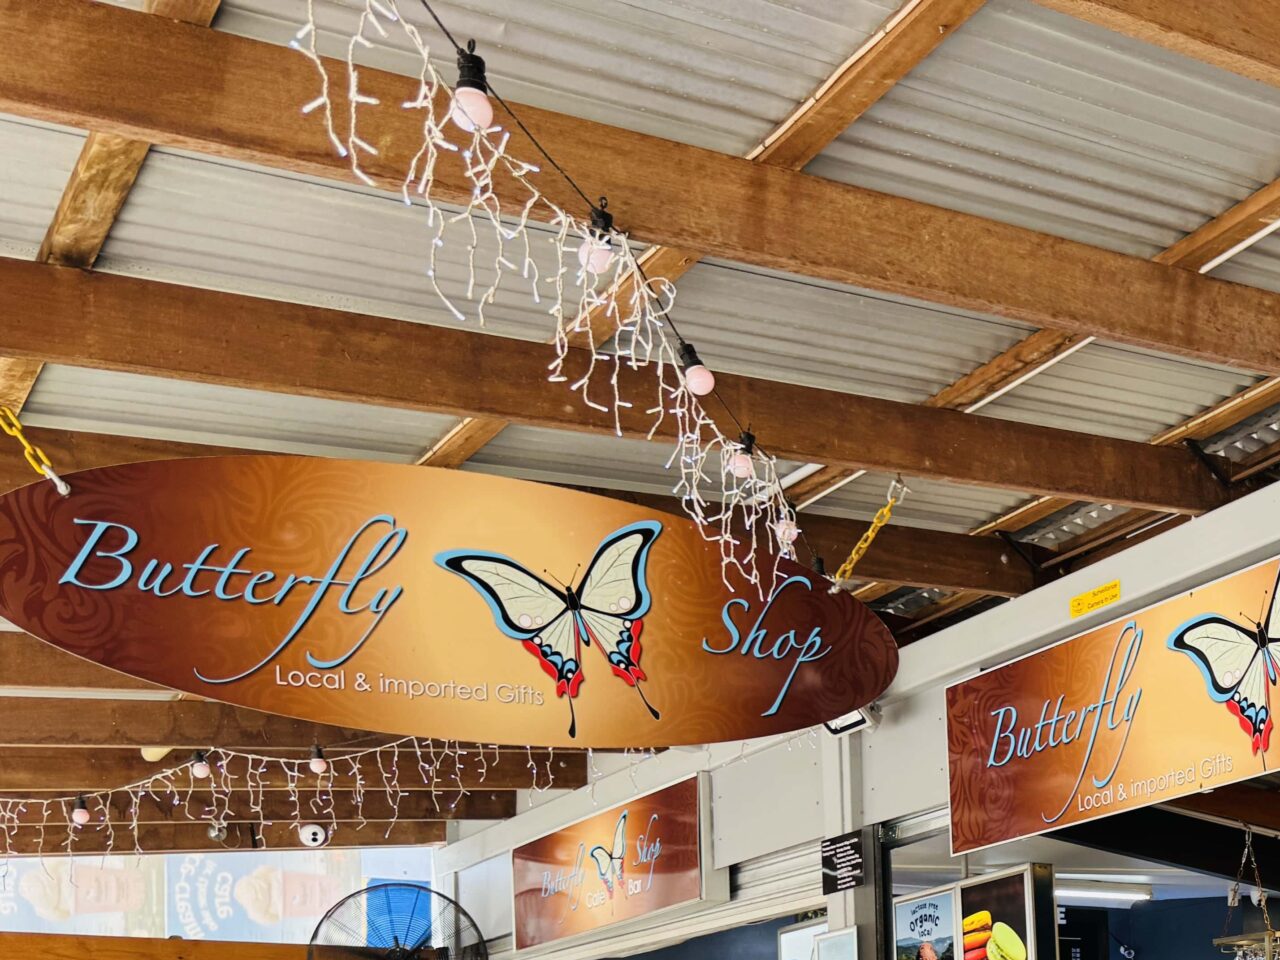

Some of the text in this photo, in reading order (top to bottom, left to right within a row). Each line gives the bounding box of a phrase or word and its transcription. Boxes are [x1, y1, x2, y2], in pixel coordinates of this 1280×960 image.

[58, 514, 408, 683] Butterfly
[274, 664, 545, 706] Local & imported Gifts
[702, 576, 832, 718] Shop
[987, 620, 1143, 823] Butterfly
[1077, 752, 1234, 812] Local & imported Gifts
[541, 842, 586, 926] Butterfly
[628, 879, 642, 895] Bar
[633, 814, 662, 892] Shop
